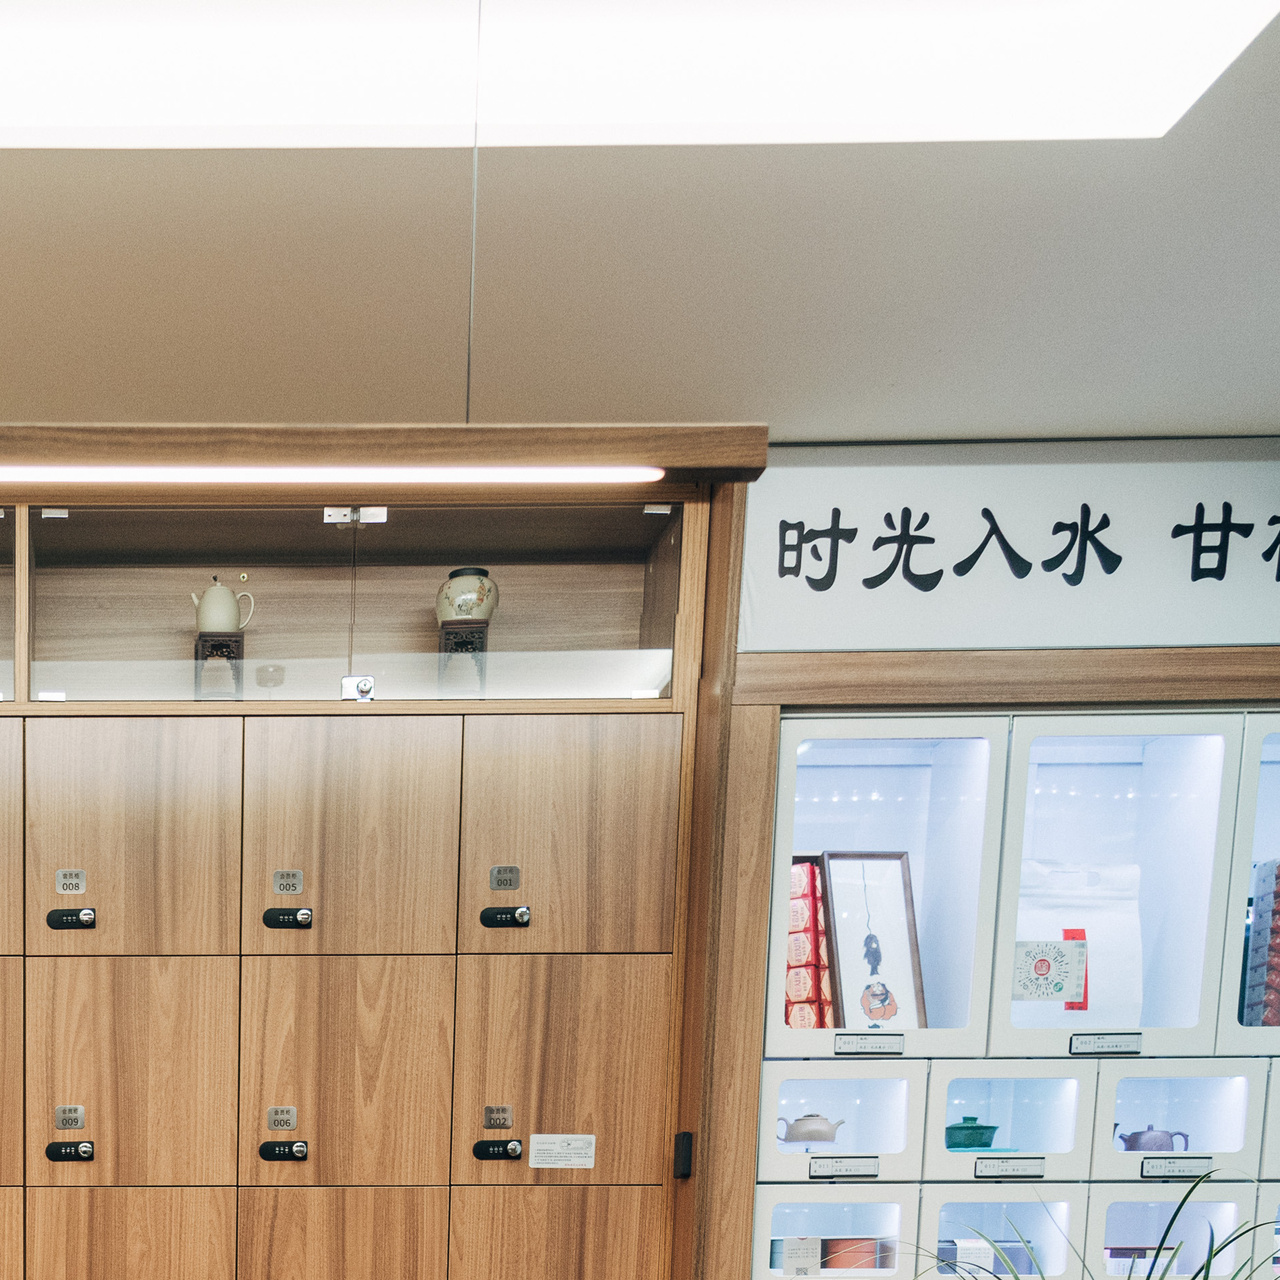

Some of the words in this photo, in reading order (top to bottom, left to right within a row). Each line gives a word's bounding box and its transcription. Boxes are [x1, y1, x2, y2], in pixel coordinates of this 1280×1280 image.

[778, 506, 1122, 593] 时光入水
[61, 882, 80, 891] 008
[279, 883, 297, 891] 005
[496, 878, 513, 887] 001
[61, 1118, 79, 1126] 009
[273, 1119, 291, 1127] 006
[489, 1117, 507, 1126] 002
